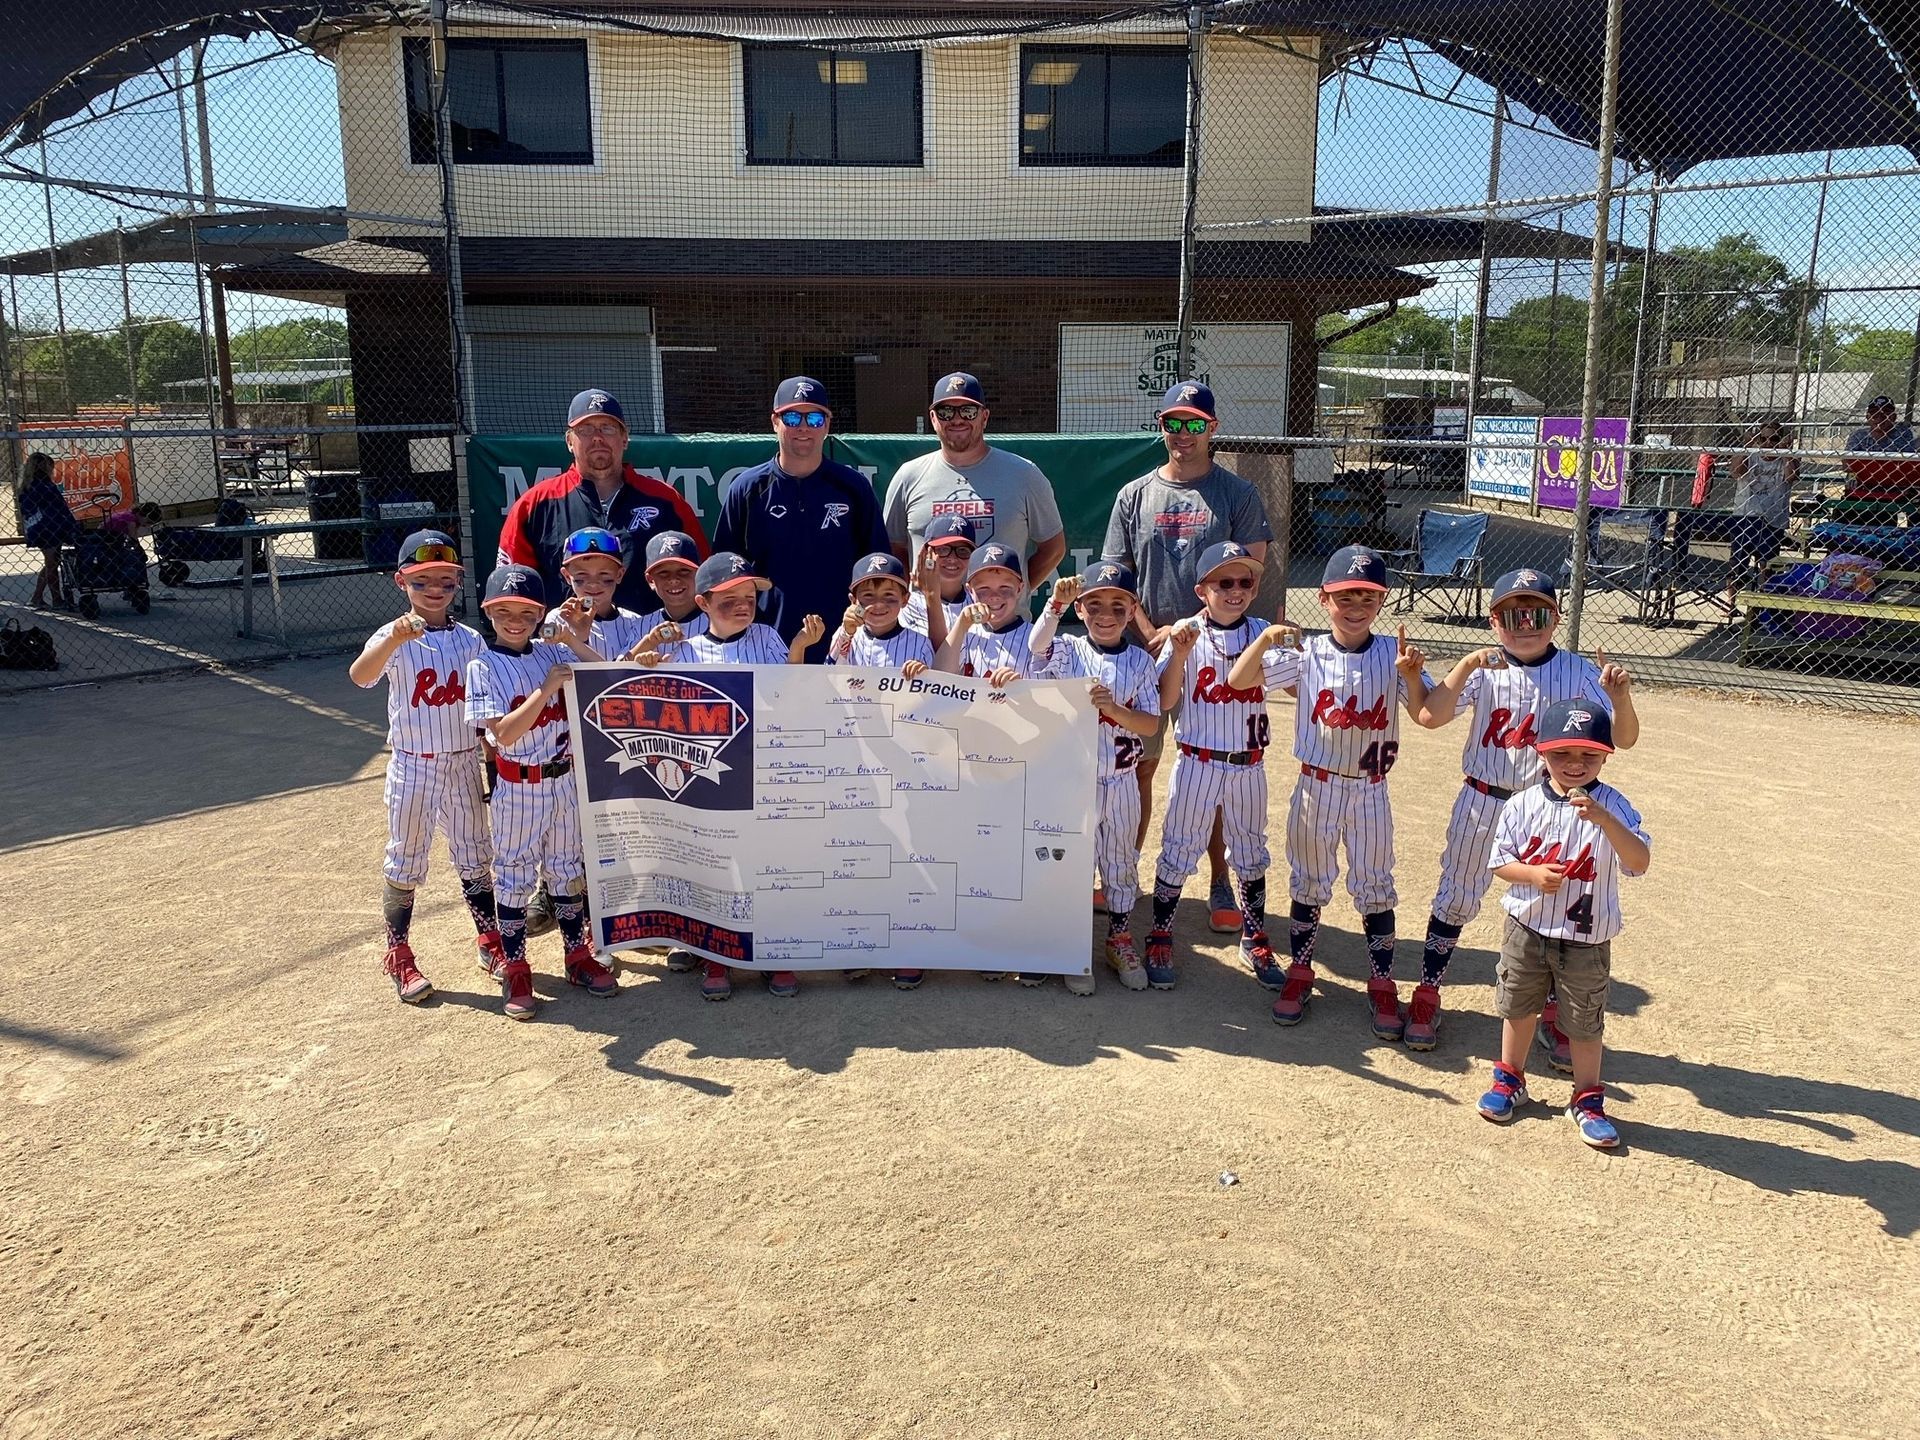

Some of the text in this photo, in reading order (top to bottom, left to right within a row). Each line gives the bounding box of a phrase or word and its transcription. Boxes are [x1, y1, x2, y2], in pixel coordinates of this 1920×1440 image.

[1144, 329, 1207, 341] MATTON
[932, 502, 995, 517] REBELS
[680, 686, 703, 699] OUT
[878, 677, 976, 702] 8U Bracket
[1311, 689, 1390, 731] Rebels
[600, 699, 730, 735] SLAM
[1246, 714, 1270, 749] 18
[628, 738, 708, 766] MATTOON HIT-MEN
[1358, 741, 1398, 777] 46
[857, 765, 888, 774] Braves
[922, 782, 947, 791] Braves
[829, 801, 848, 810] Paris
[1033, 820, 1064, 832] Rebels
[909, 853, 935, 862] Rebels
[833, 871, 855, 879] Rebels
[969, 887, 993, 897] Rebels
[1567, 893, 1594, 935] 4
[614, 913, 685, 929] MATTOON
[921, 923, 936, 934] Dogs
[680, 932, 705, 946] OUT
[708, 940, 746, 960] SLAM
[858, 941, 876, 952] Dogs
